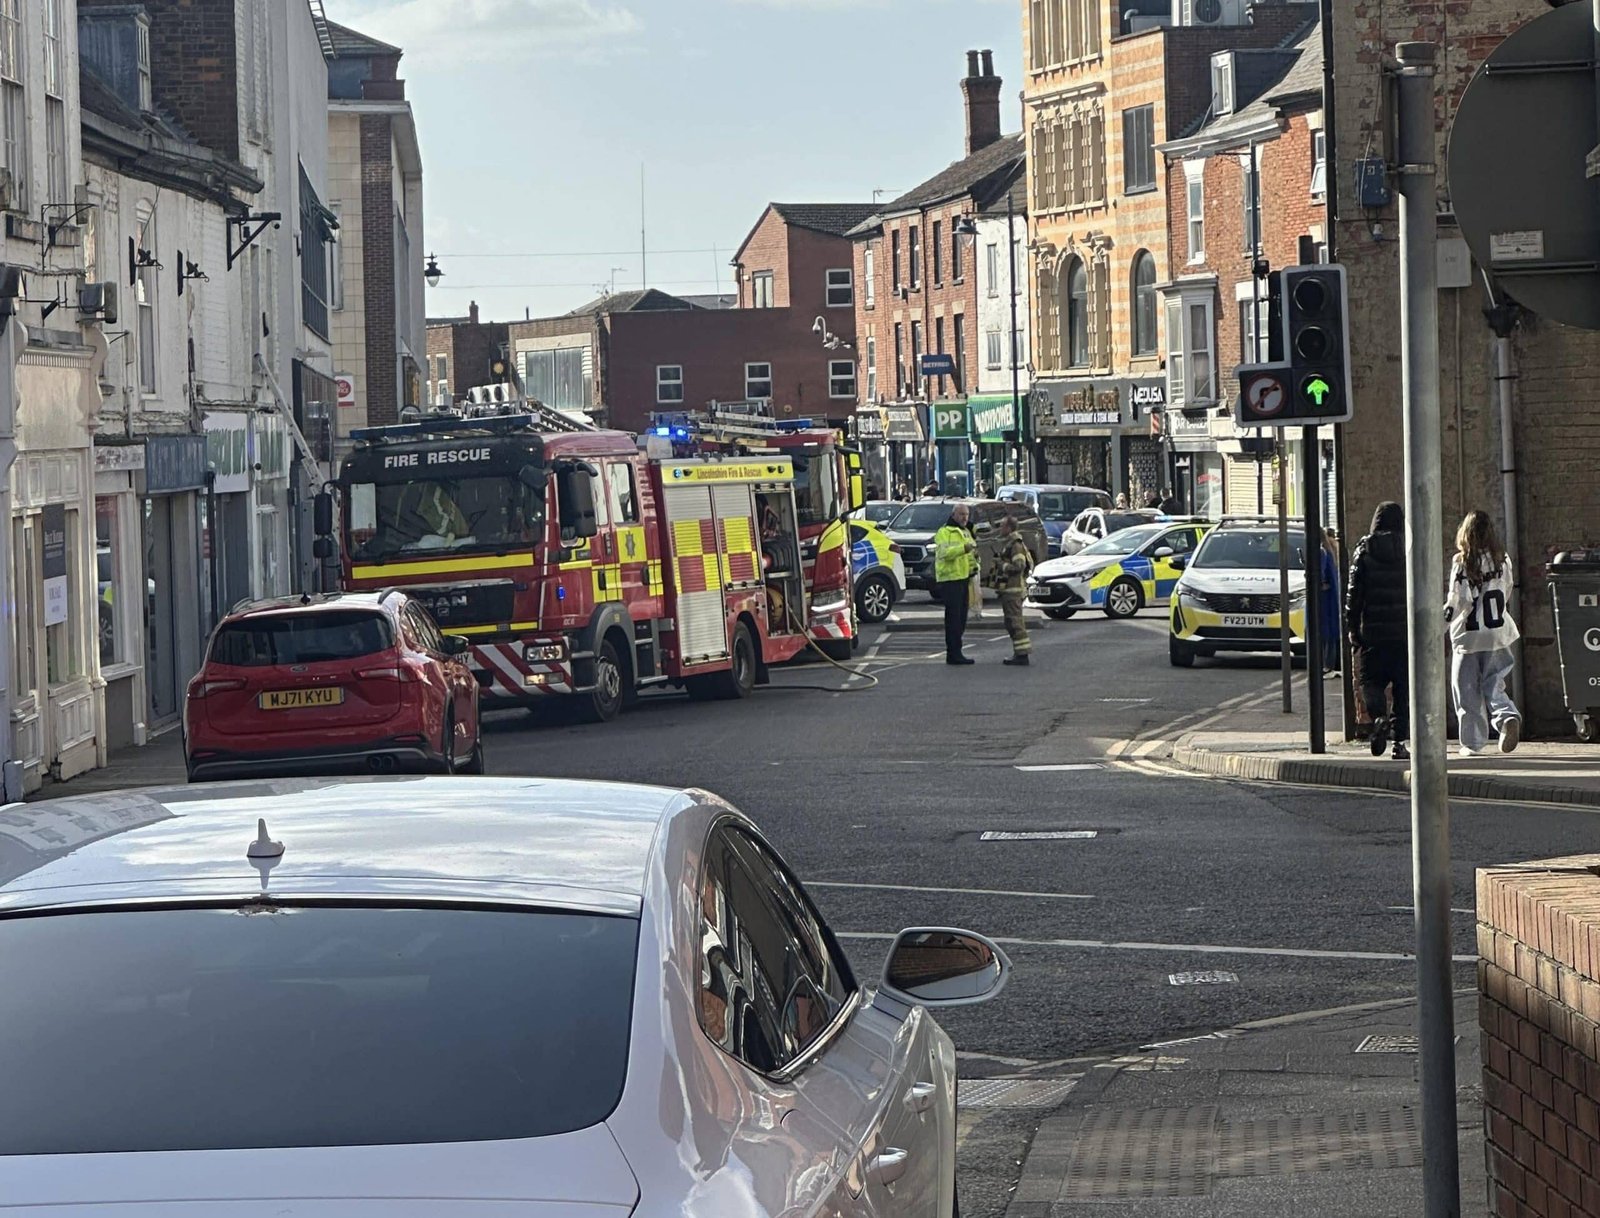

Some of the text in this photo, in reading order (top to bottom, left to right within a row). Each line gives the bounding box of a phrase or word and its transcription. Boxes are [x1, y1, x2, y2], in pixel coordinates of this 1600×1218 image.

[384, 448, 491, 468] FIRE RESCUE
[697, 468, 728, 479] Lincolnshire
[728, 468, 738, 478] Fire
[744, 467, 762, 478] Rescue
[1466, 589, 1505, 631] 10
[1224, 616, 1265, 625] FV23 UTM
[270, 690, 332, 706] MJ71 KYU
